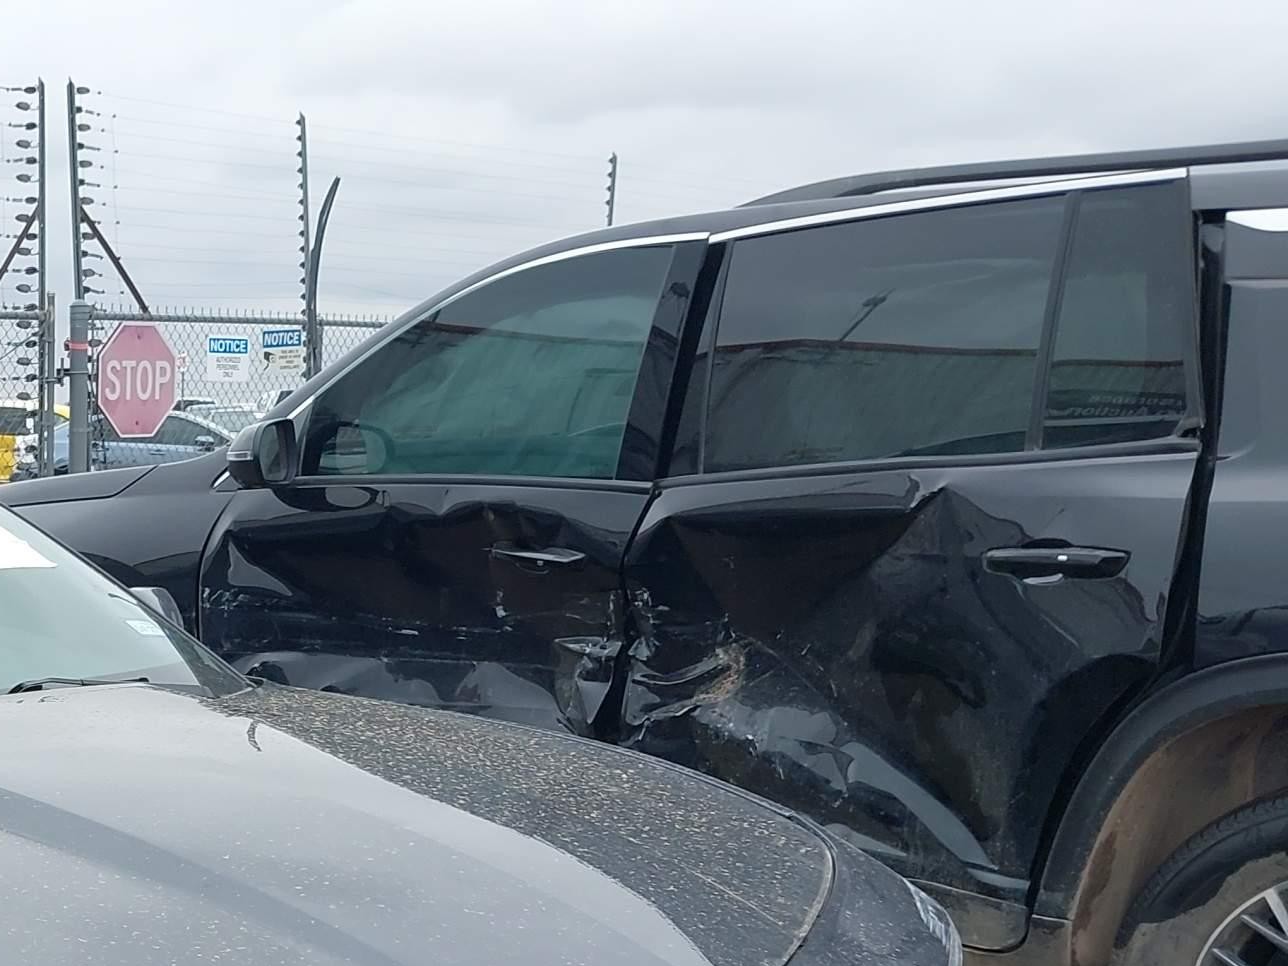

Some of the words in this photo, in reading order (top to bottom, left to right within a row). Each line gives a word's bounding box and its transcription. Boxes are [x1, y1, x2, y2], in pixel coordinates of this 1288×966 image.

[263, 332, 300, 346] NOTICE
[210, 340, 247, 353] NOTICE
[104, 360, 172, 401] STOP
